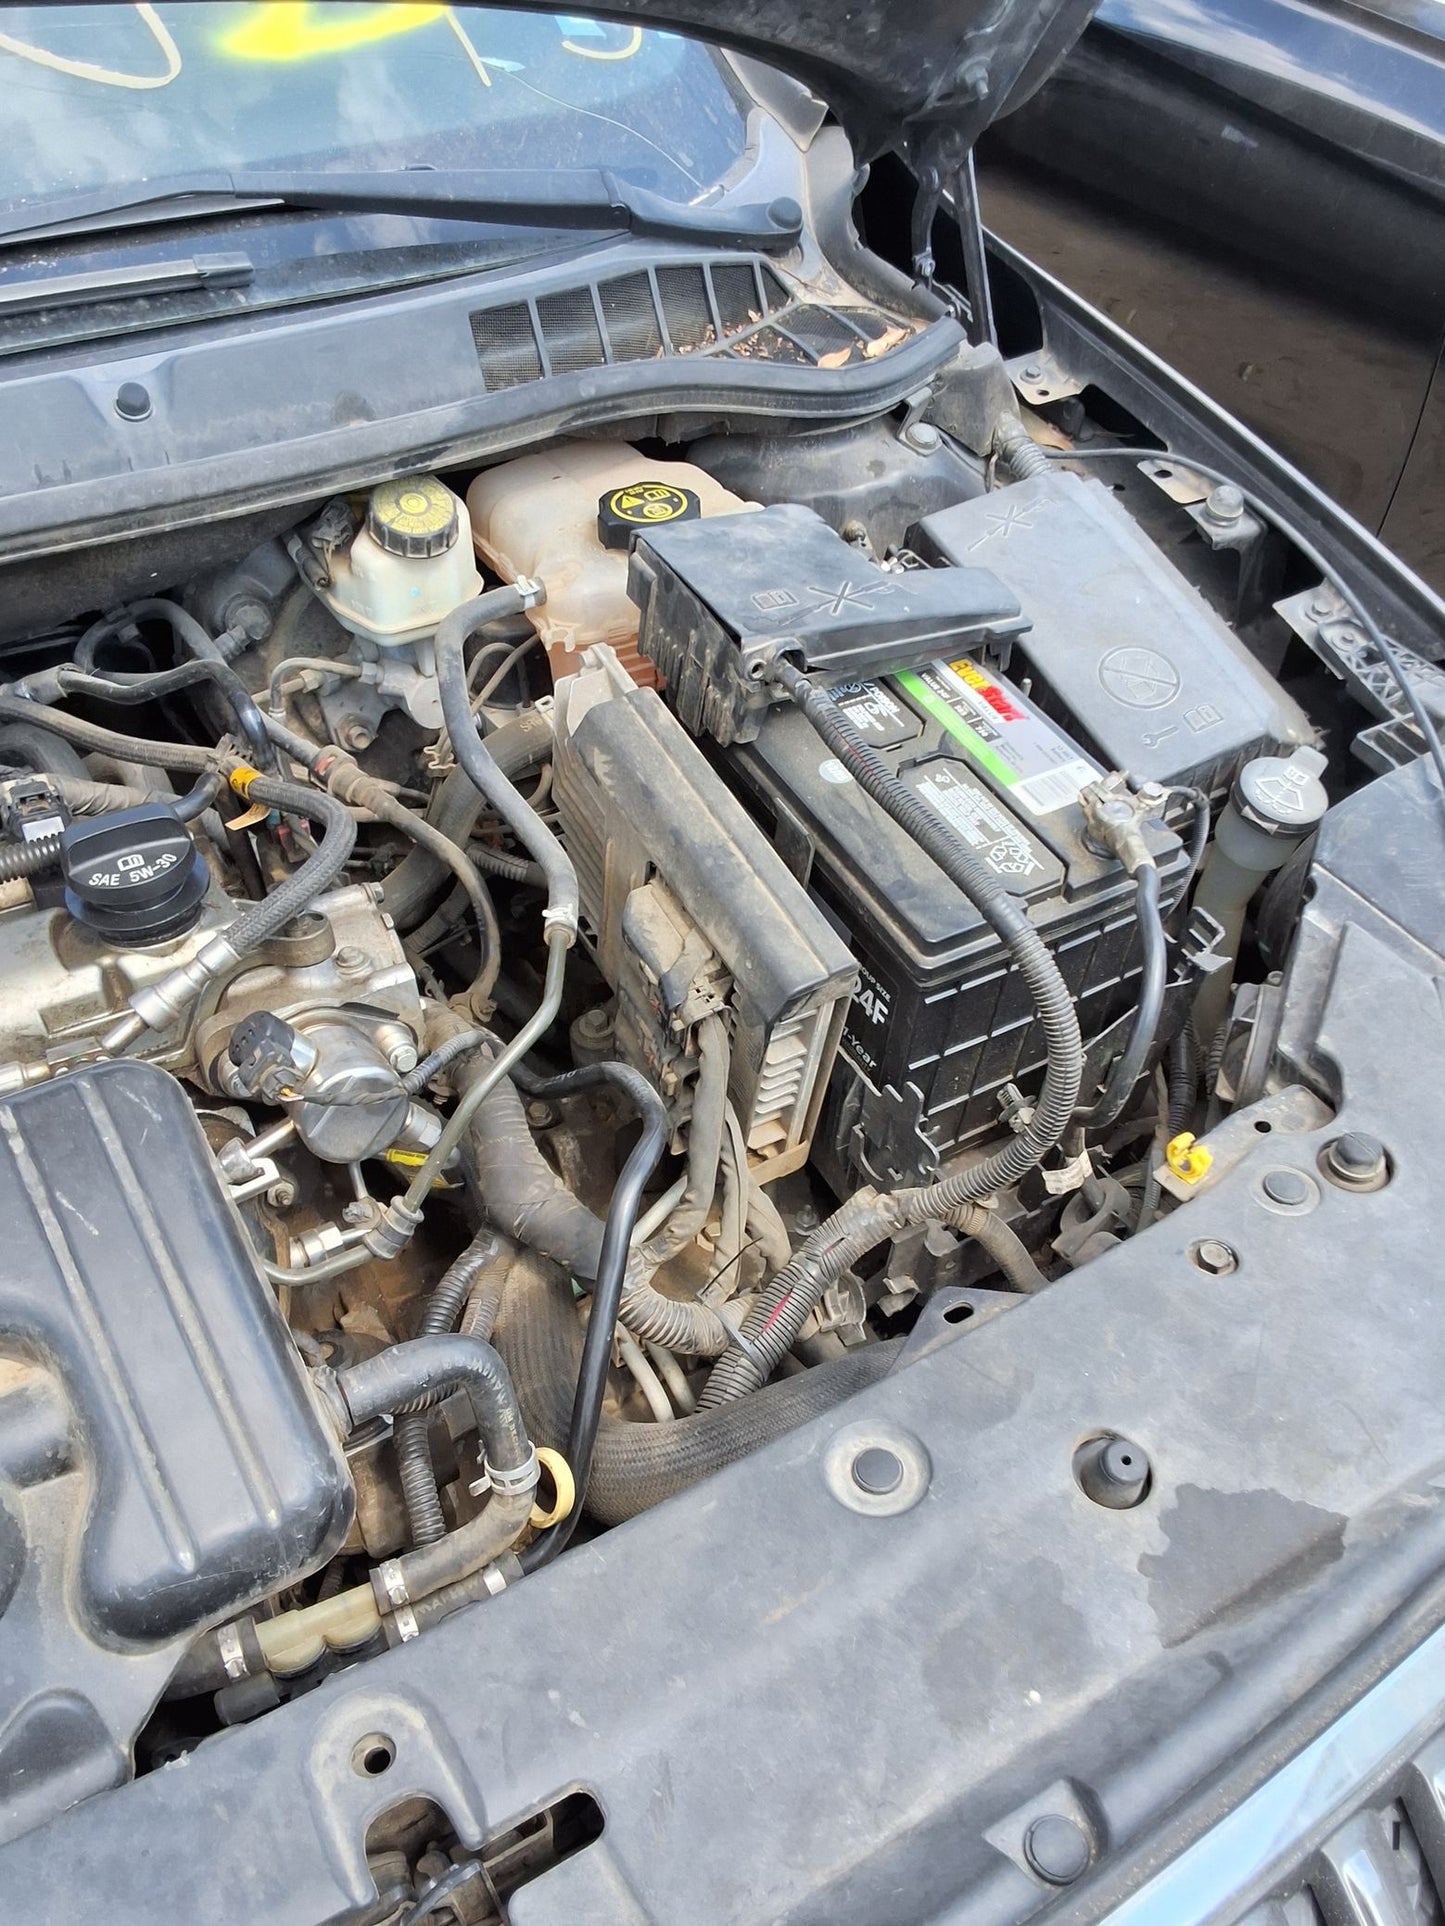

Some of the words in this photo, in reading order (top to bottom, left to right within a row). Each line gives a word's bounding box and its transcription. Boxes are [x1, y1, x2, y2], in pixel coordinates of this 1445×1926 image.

[948, 657, 1029, 723] EverStart
[88, 872, 121, 886] SAE
[129, 853, 178, 882] 5W-30
